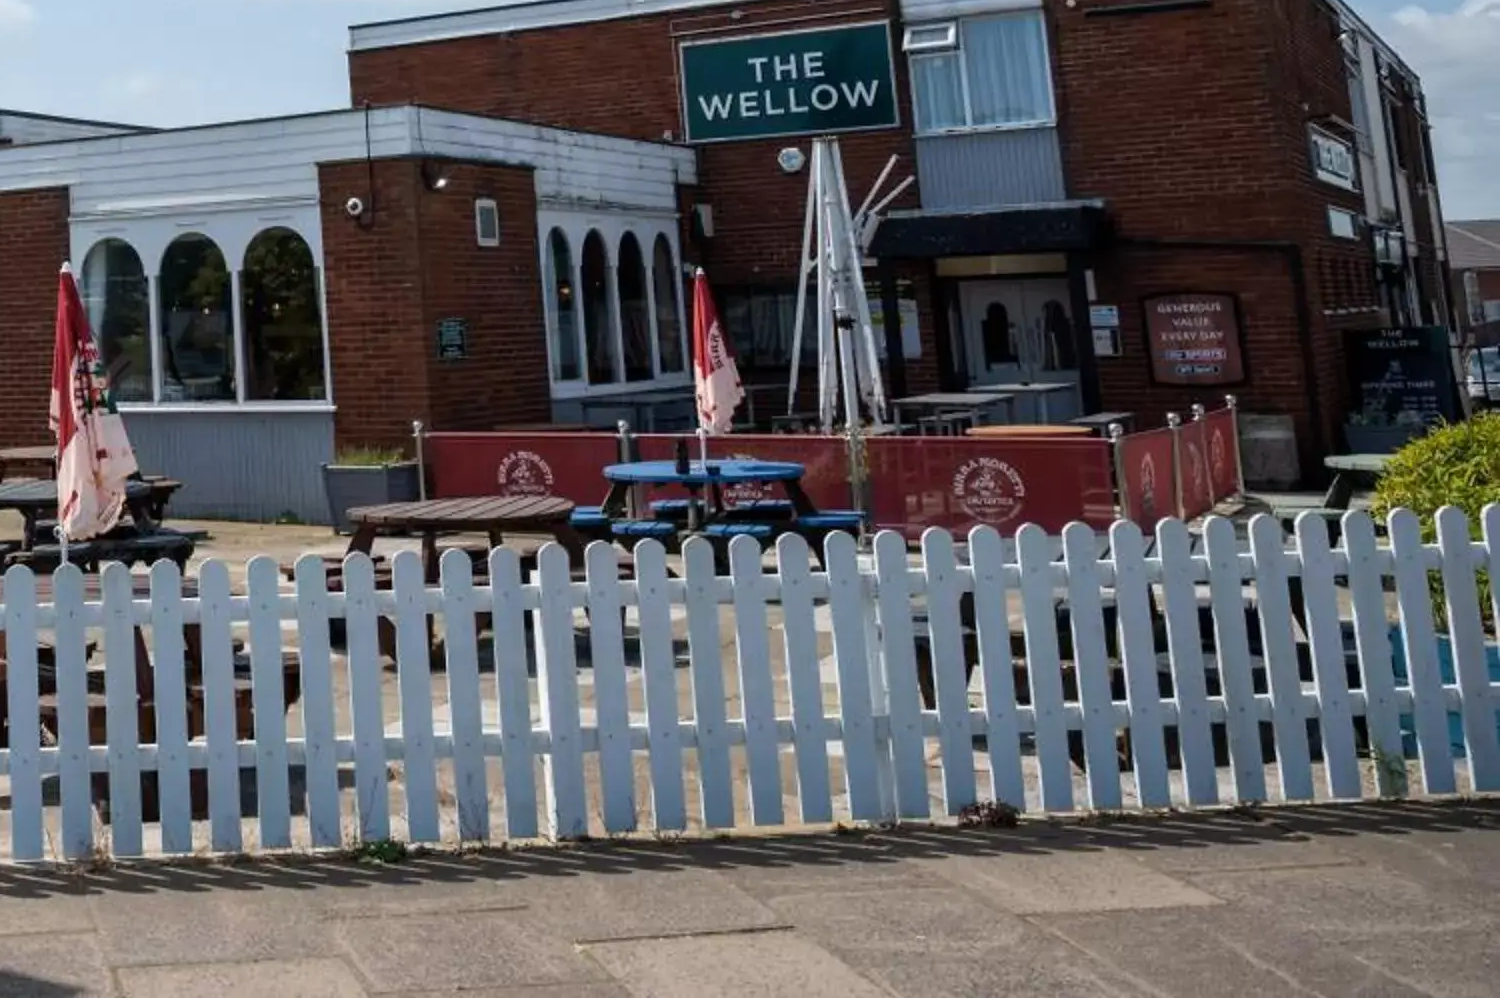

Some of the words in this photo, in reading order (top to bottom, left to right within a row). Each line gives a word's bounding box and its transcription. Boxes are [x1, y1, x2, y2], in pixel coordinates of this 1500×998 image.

[747, 51, 826, 83] THE
[697, 79, 880, 122] WELLOW
[1156, 302, 1221, 314] GENEROUS
[1161, 331, 1197, 341] EVERY
[1199, 331, 1224, 340] DAY
